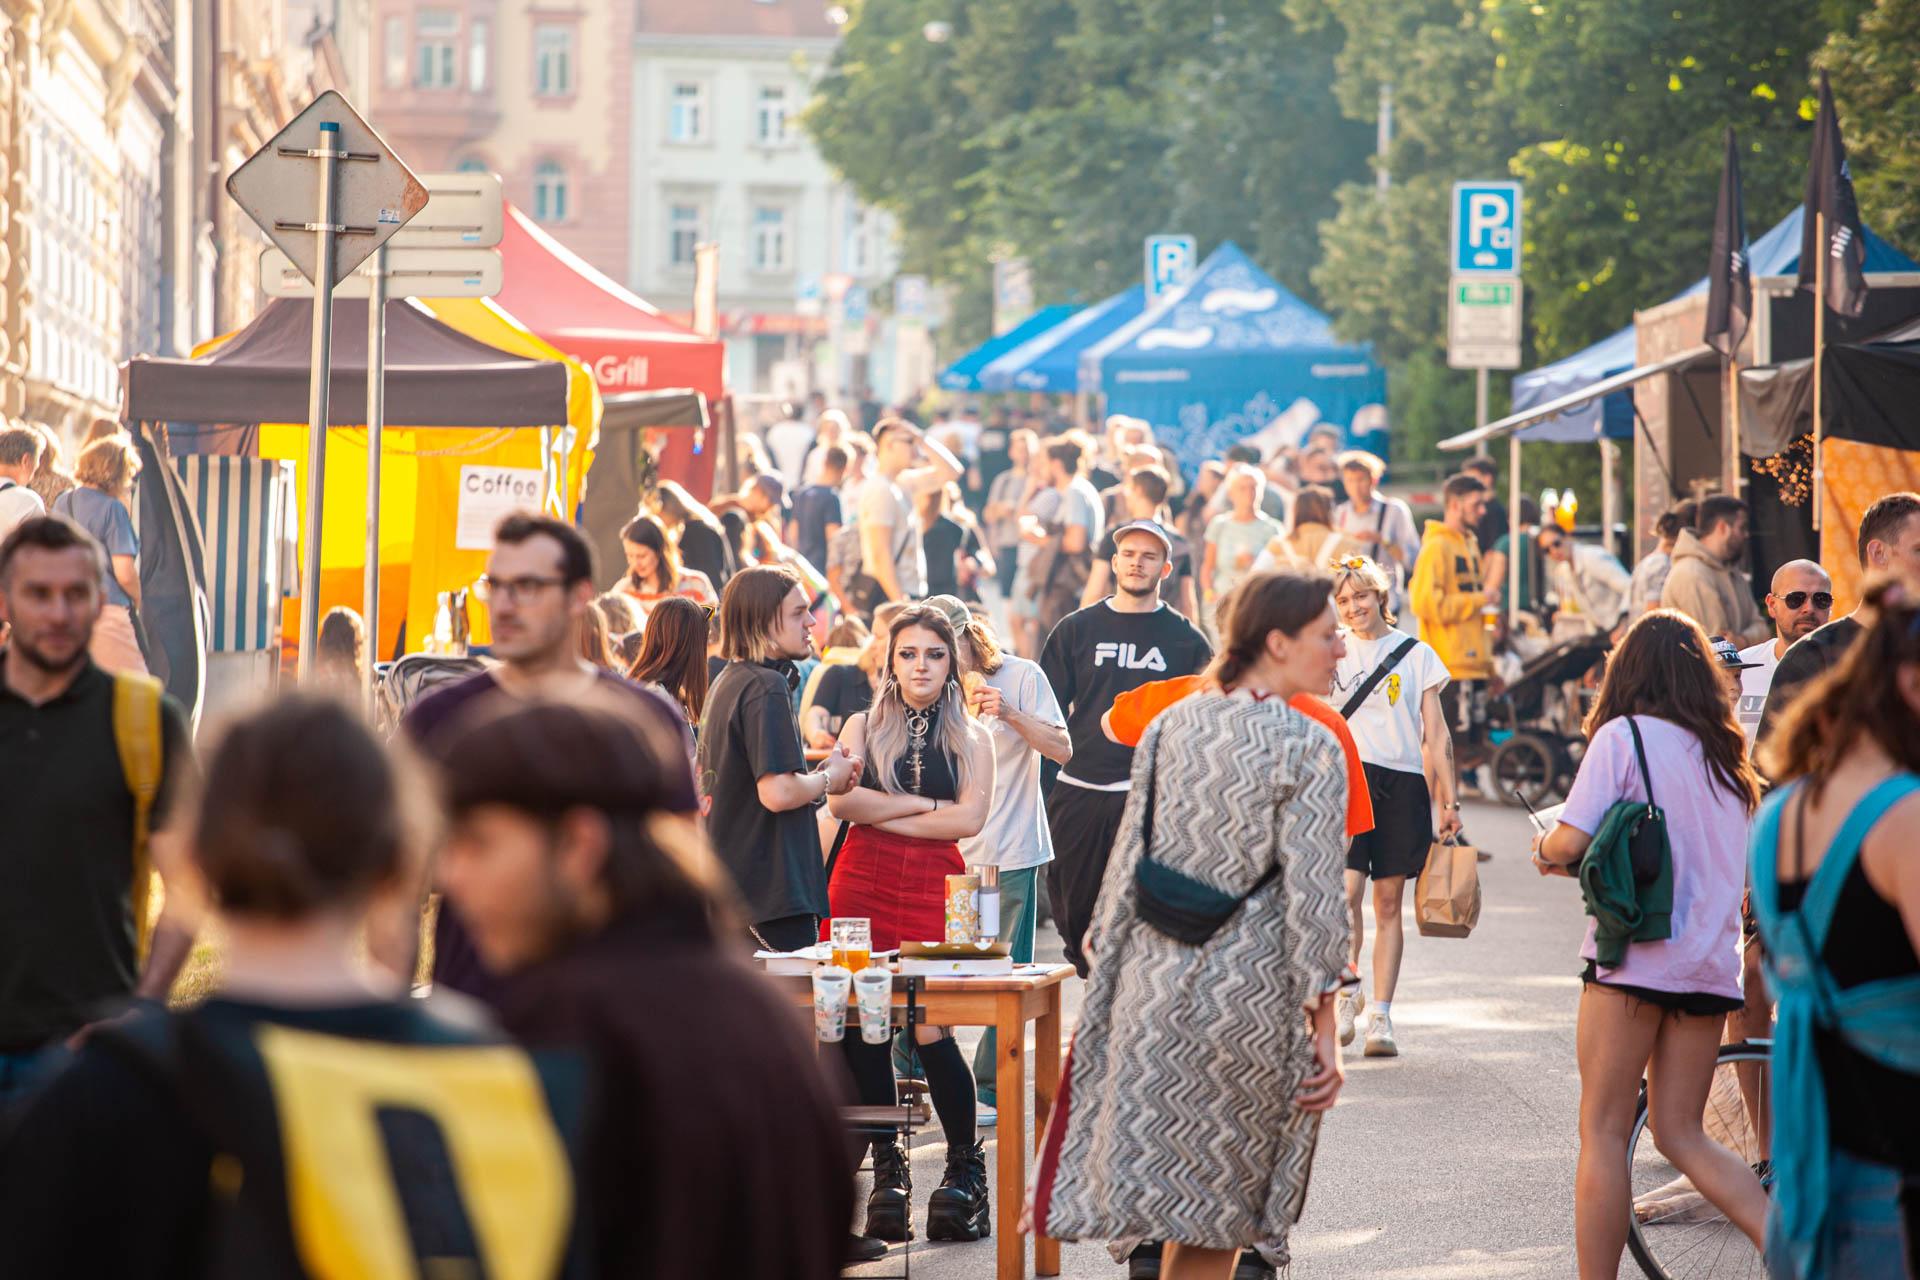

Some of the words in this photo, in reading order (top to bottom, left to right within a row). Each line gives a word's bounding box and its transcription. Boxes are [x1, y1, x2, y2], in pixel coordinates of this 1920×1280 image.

[1469, 193, 1510, 248] P
[594, 354, 649, 386] Grill
[465, 473, 537, 496] Coffee
[1094, 642, 1167, 672] FILA
